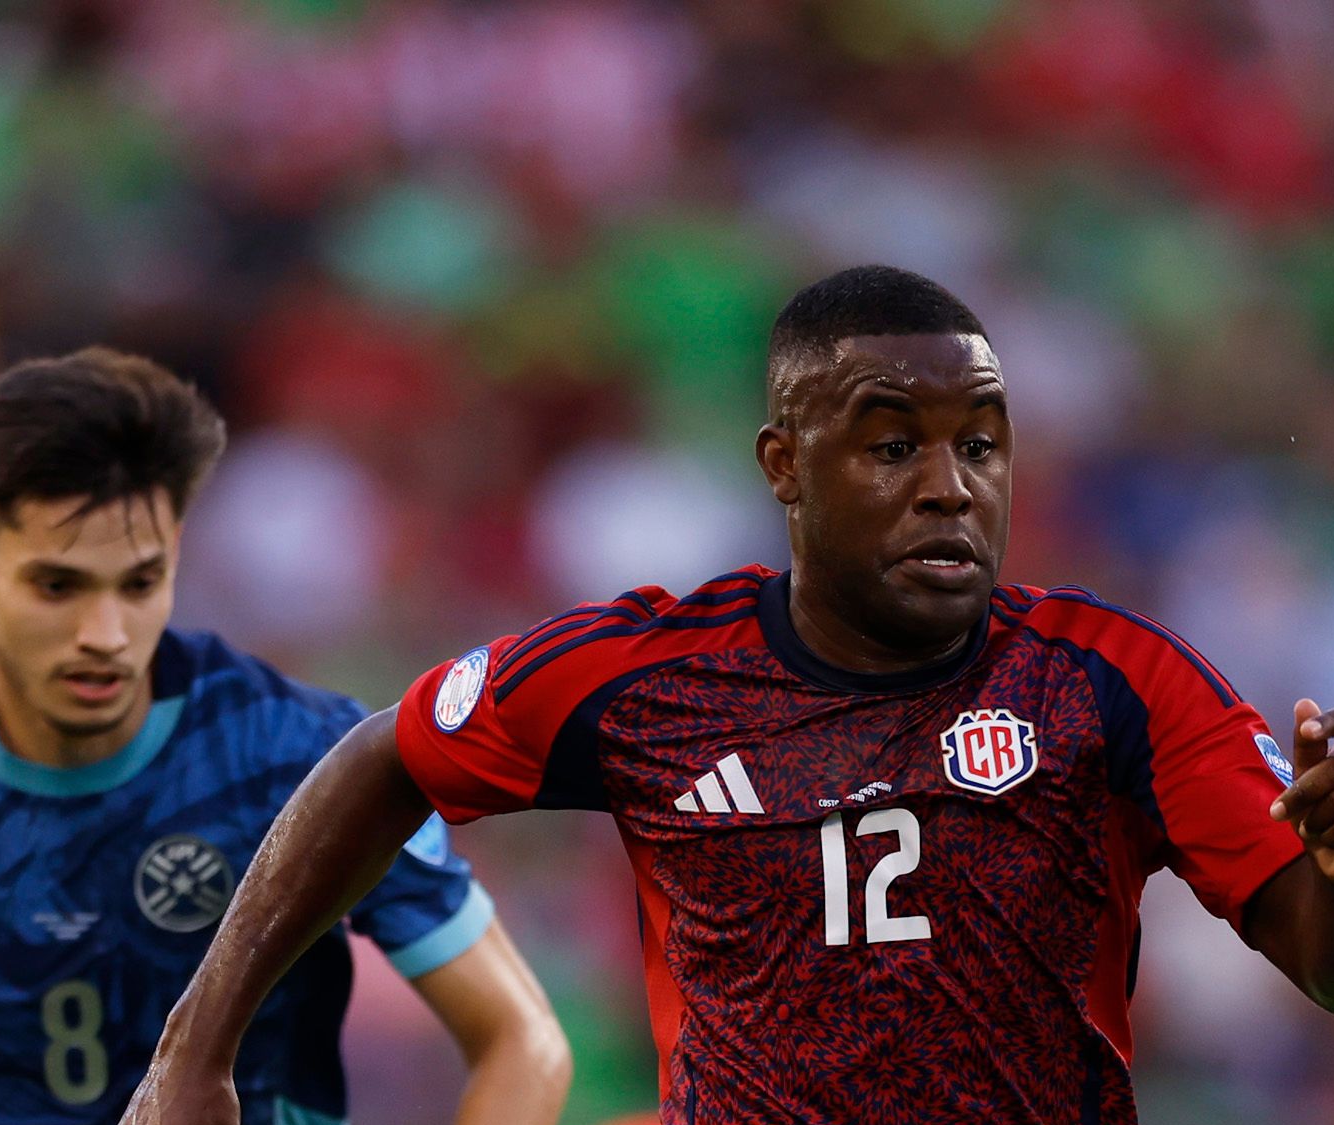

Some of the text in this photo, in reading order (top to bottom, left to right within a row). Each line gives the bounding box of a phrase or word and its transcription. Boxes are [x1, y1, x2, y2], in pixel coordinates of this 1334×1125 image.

[963, 726, 1016, 779] CR
[820, 807, 932, 946] 12
[42, 979, 109, 1106] 8
